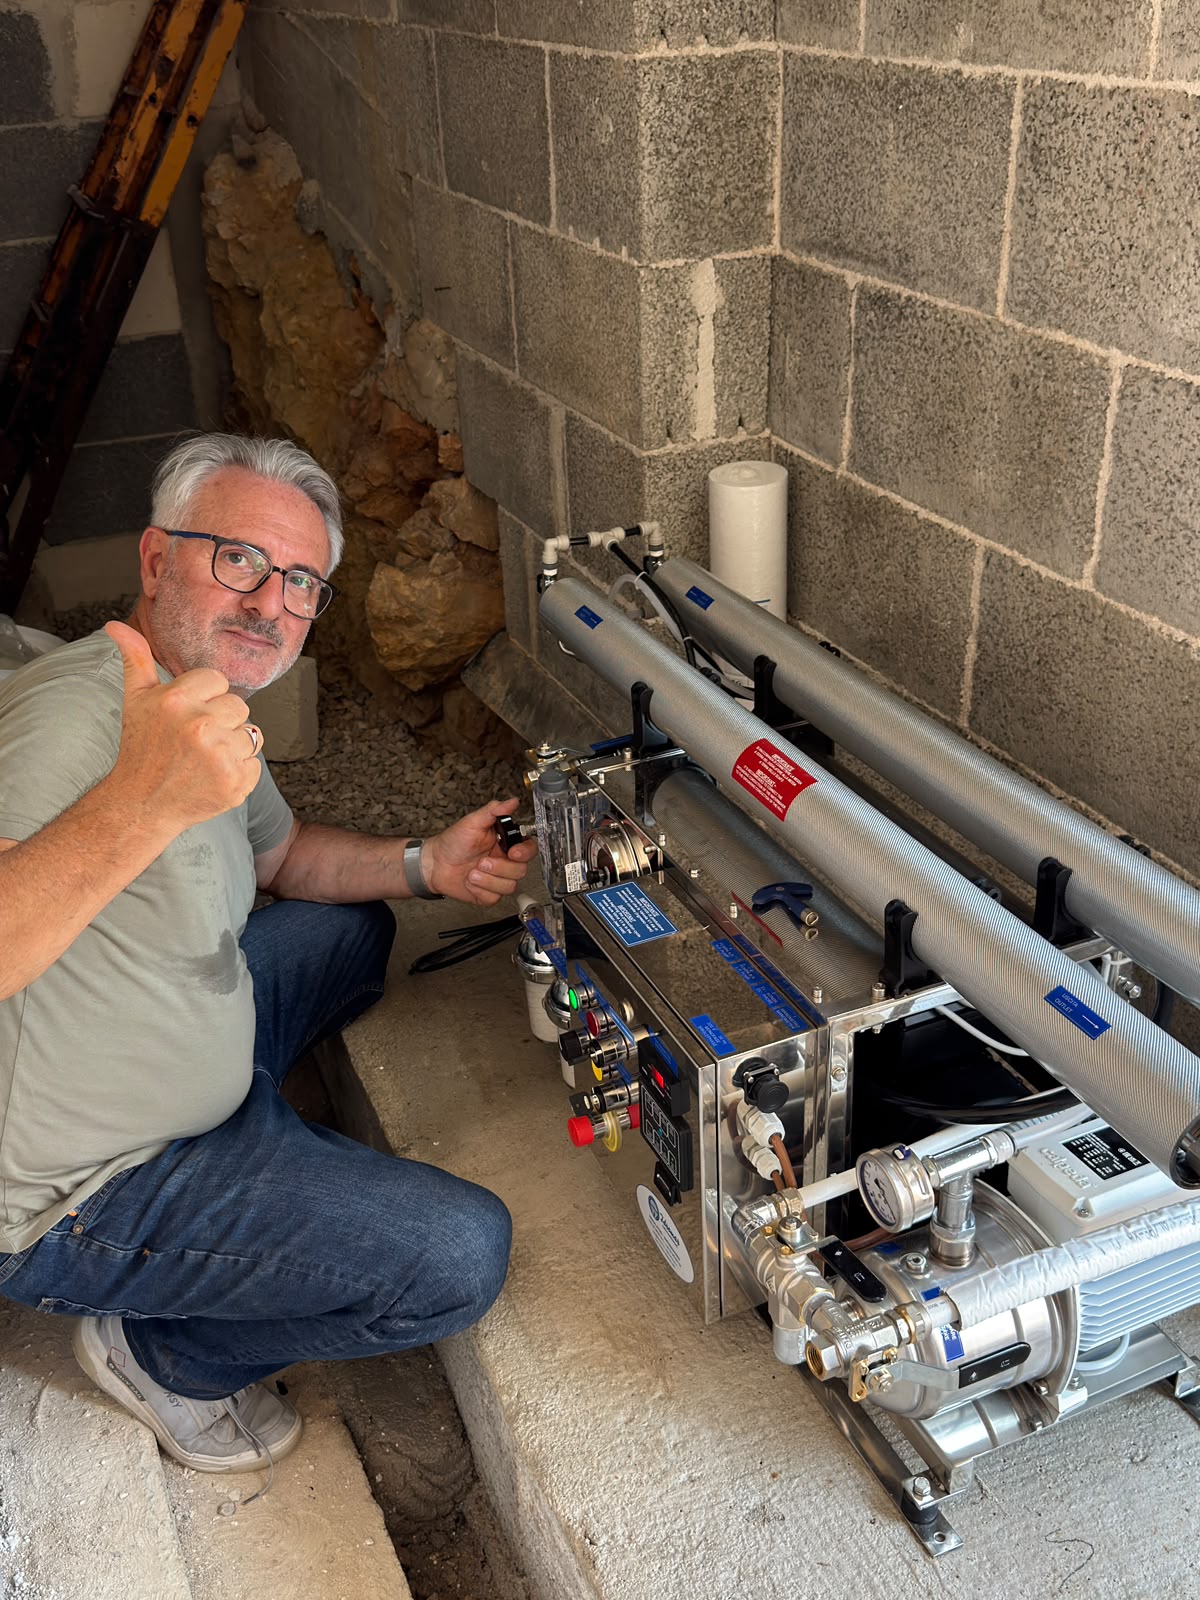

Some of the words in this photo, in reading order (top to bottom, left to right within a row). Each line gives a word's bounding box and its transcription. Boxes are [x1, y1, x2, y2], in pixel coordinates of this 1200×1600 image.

[1055, 998, 1073, 1013] OUTLET
[1062, 993, 1079, 1008] USCITA
[1040, 1147, 1092, 1189] calpeda
